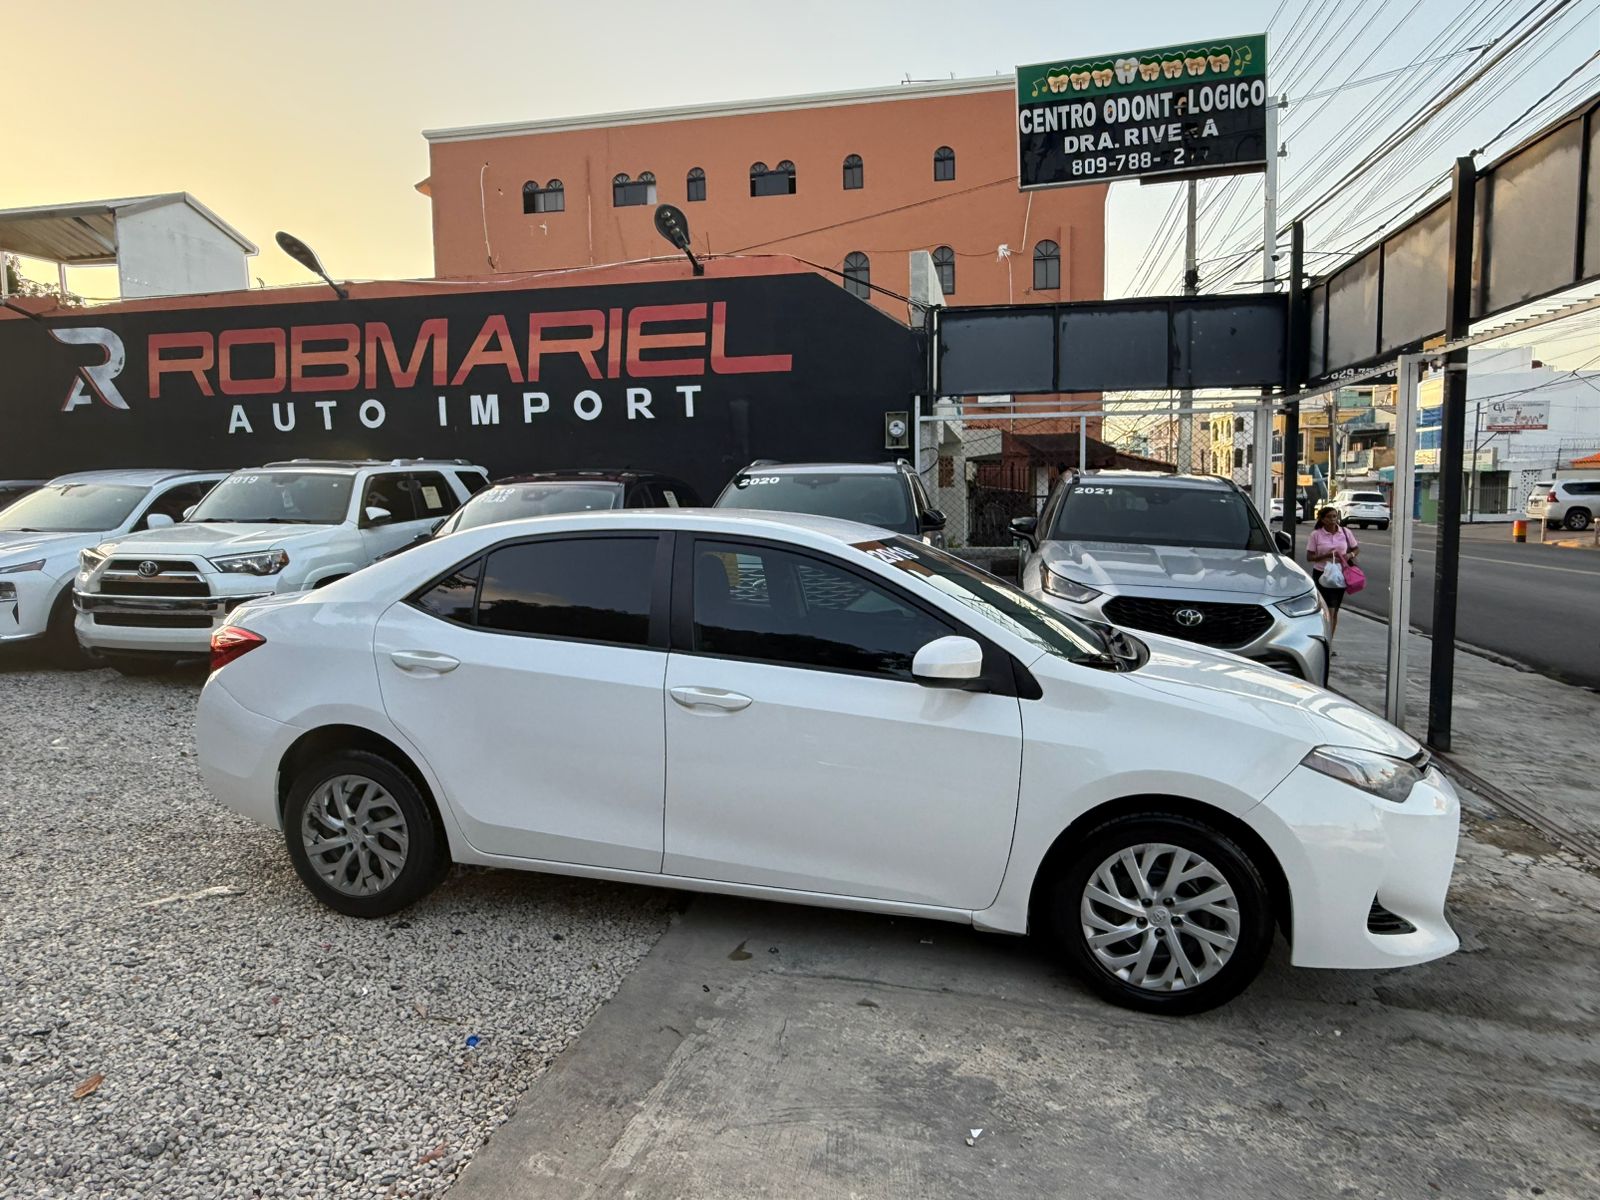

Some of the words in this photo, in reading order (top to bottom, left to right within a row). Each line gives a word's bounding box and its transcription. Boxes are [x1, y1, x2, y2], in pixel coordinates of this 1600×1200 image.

[1019, 101, 1097, 135] CENTRO
[1064, 131, 1120, 154] DRA.
[147, 301, 793, 399] ROBMARIEL
[228, 401, 387, 434] AUTO
[438, 385, 703, 427] IMPORT
[739, 476, 780, 487] 2020
[1074, 486, 1114, 495] 2021
[866, 546, 920, 564] 2019
